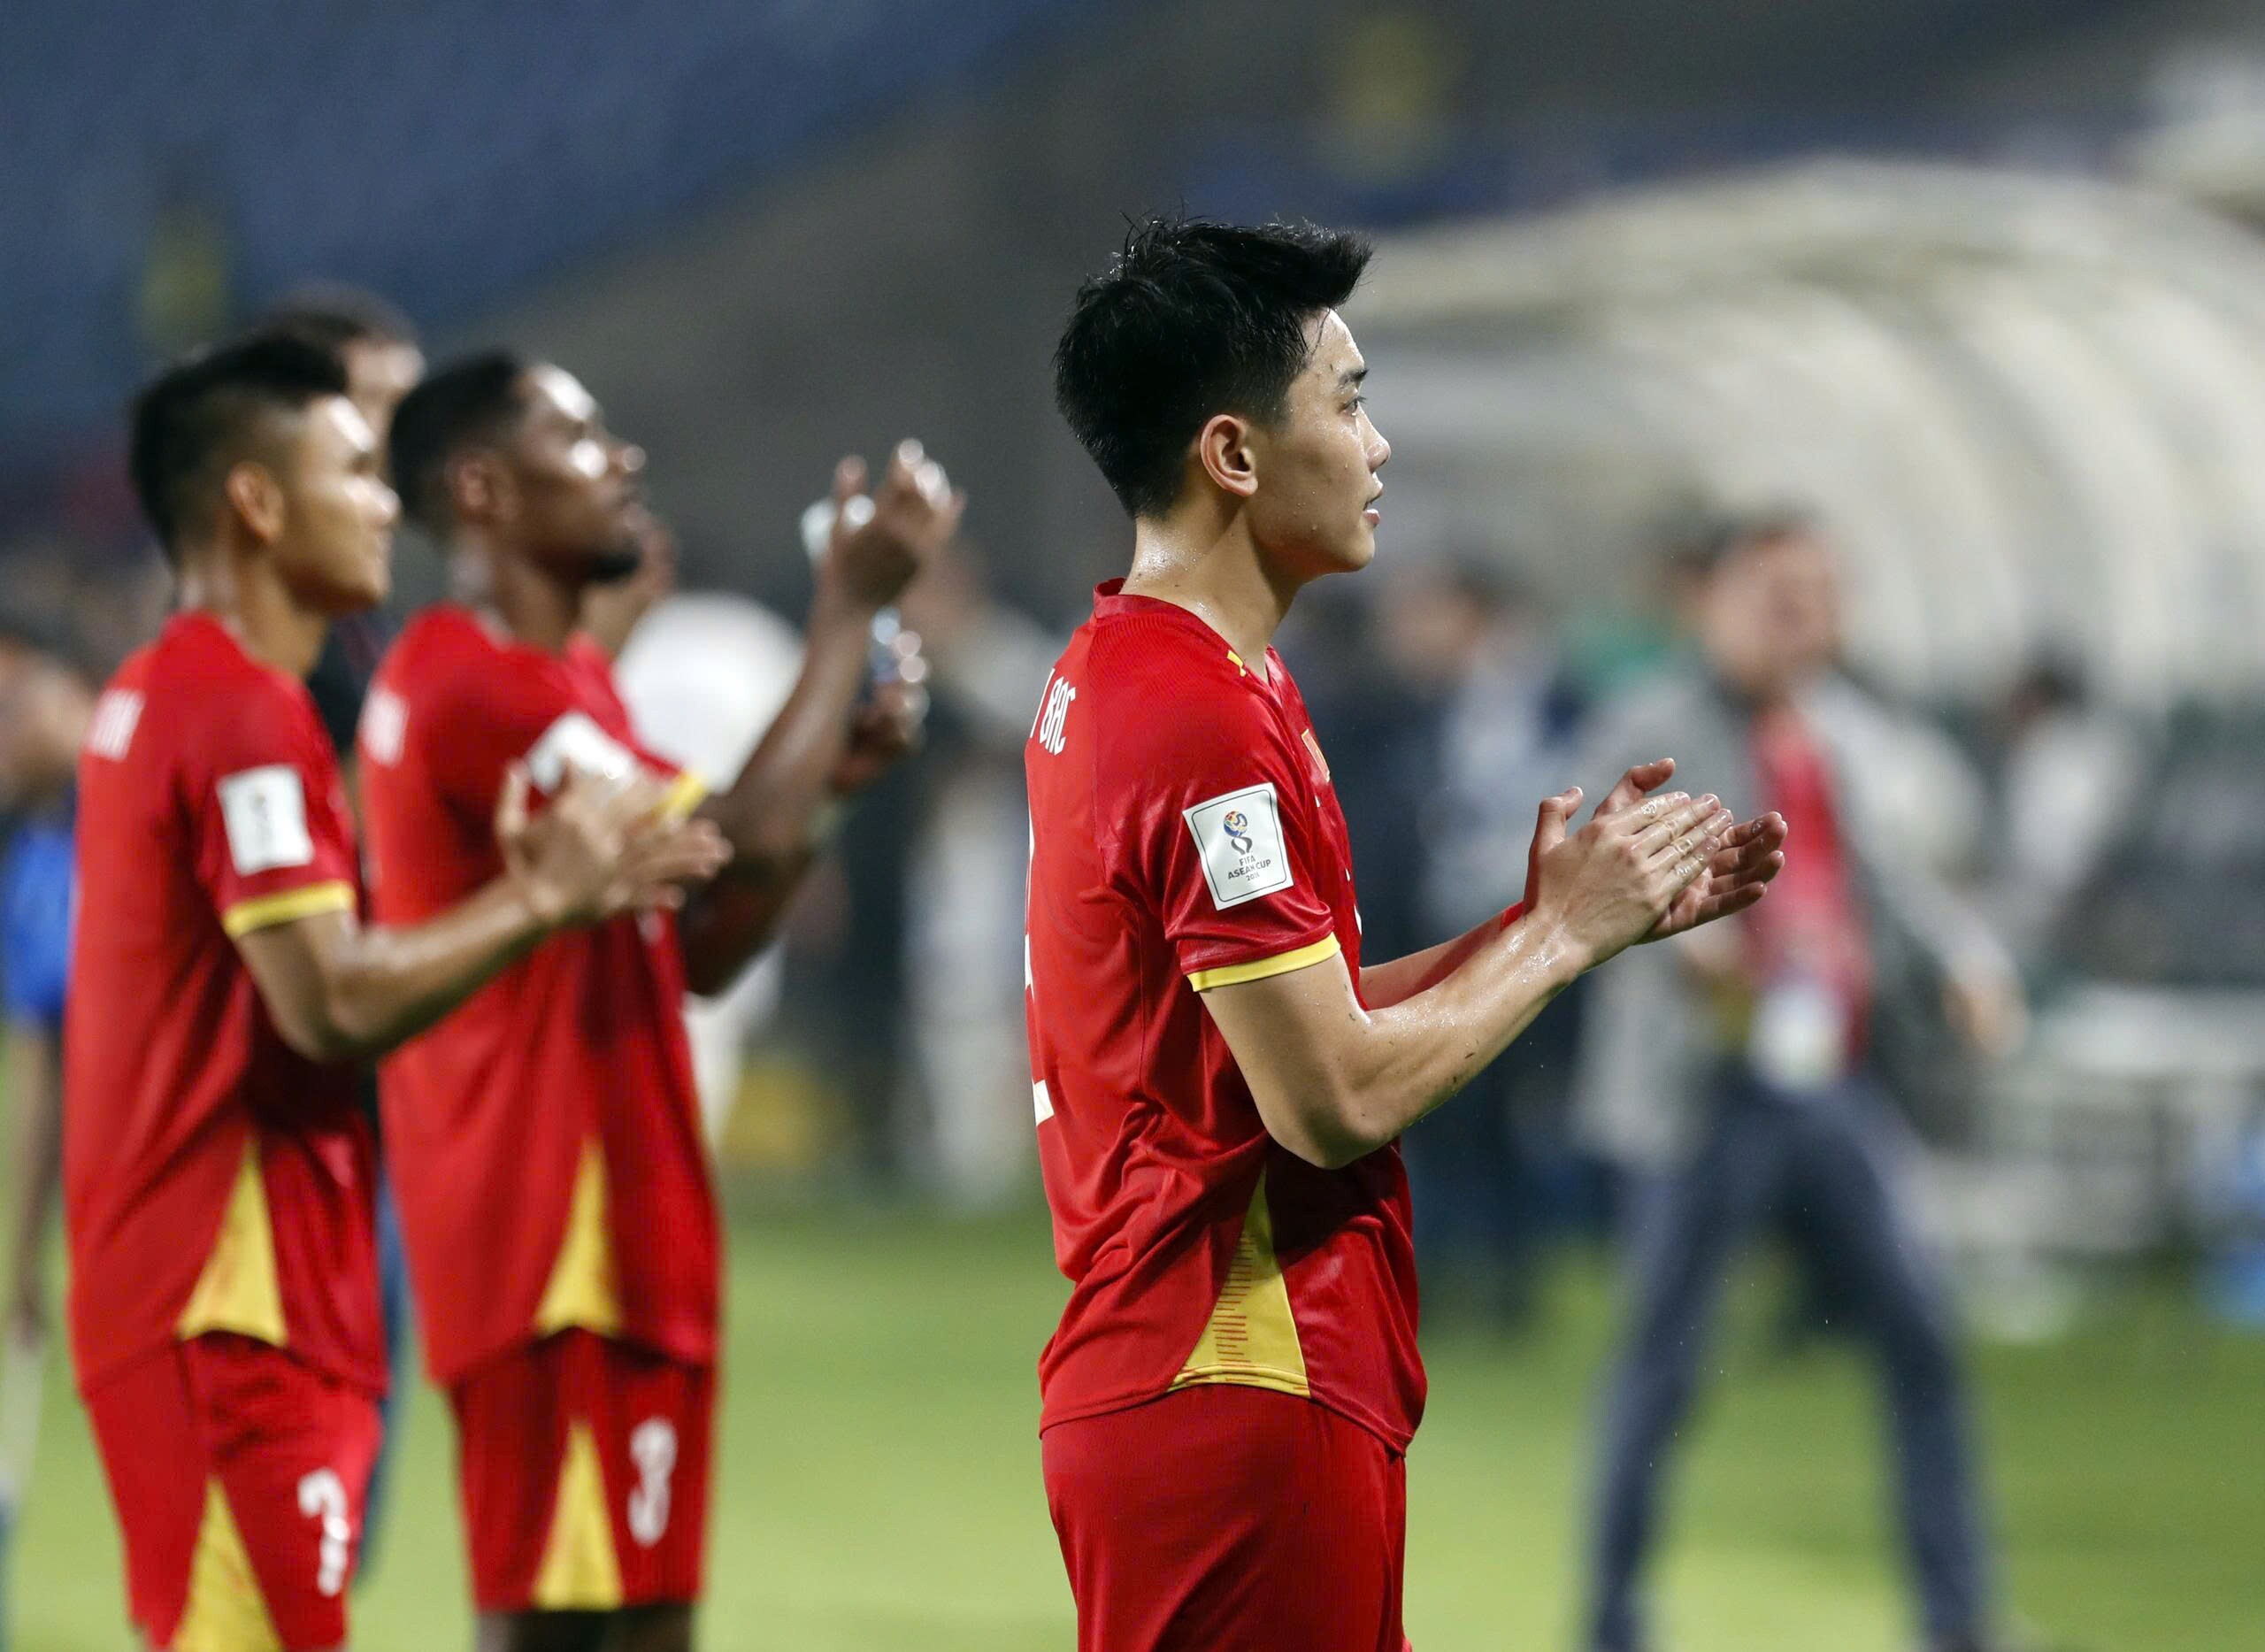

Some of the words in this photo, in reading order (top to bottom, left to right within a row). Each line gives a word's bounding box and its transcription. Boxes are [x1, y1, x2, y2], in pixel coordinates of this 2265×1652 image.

[1239, 855, 1255, 866] FIFA
[1228, 864, 1255, 880] ASEAN
[1255, 858, 1271, 870] CUP
